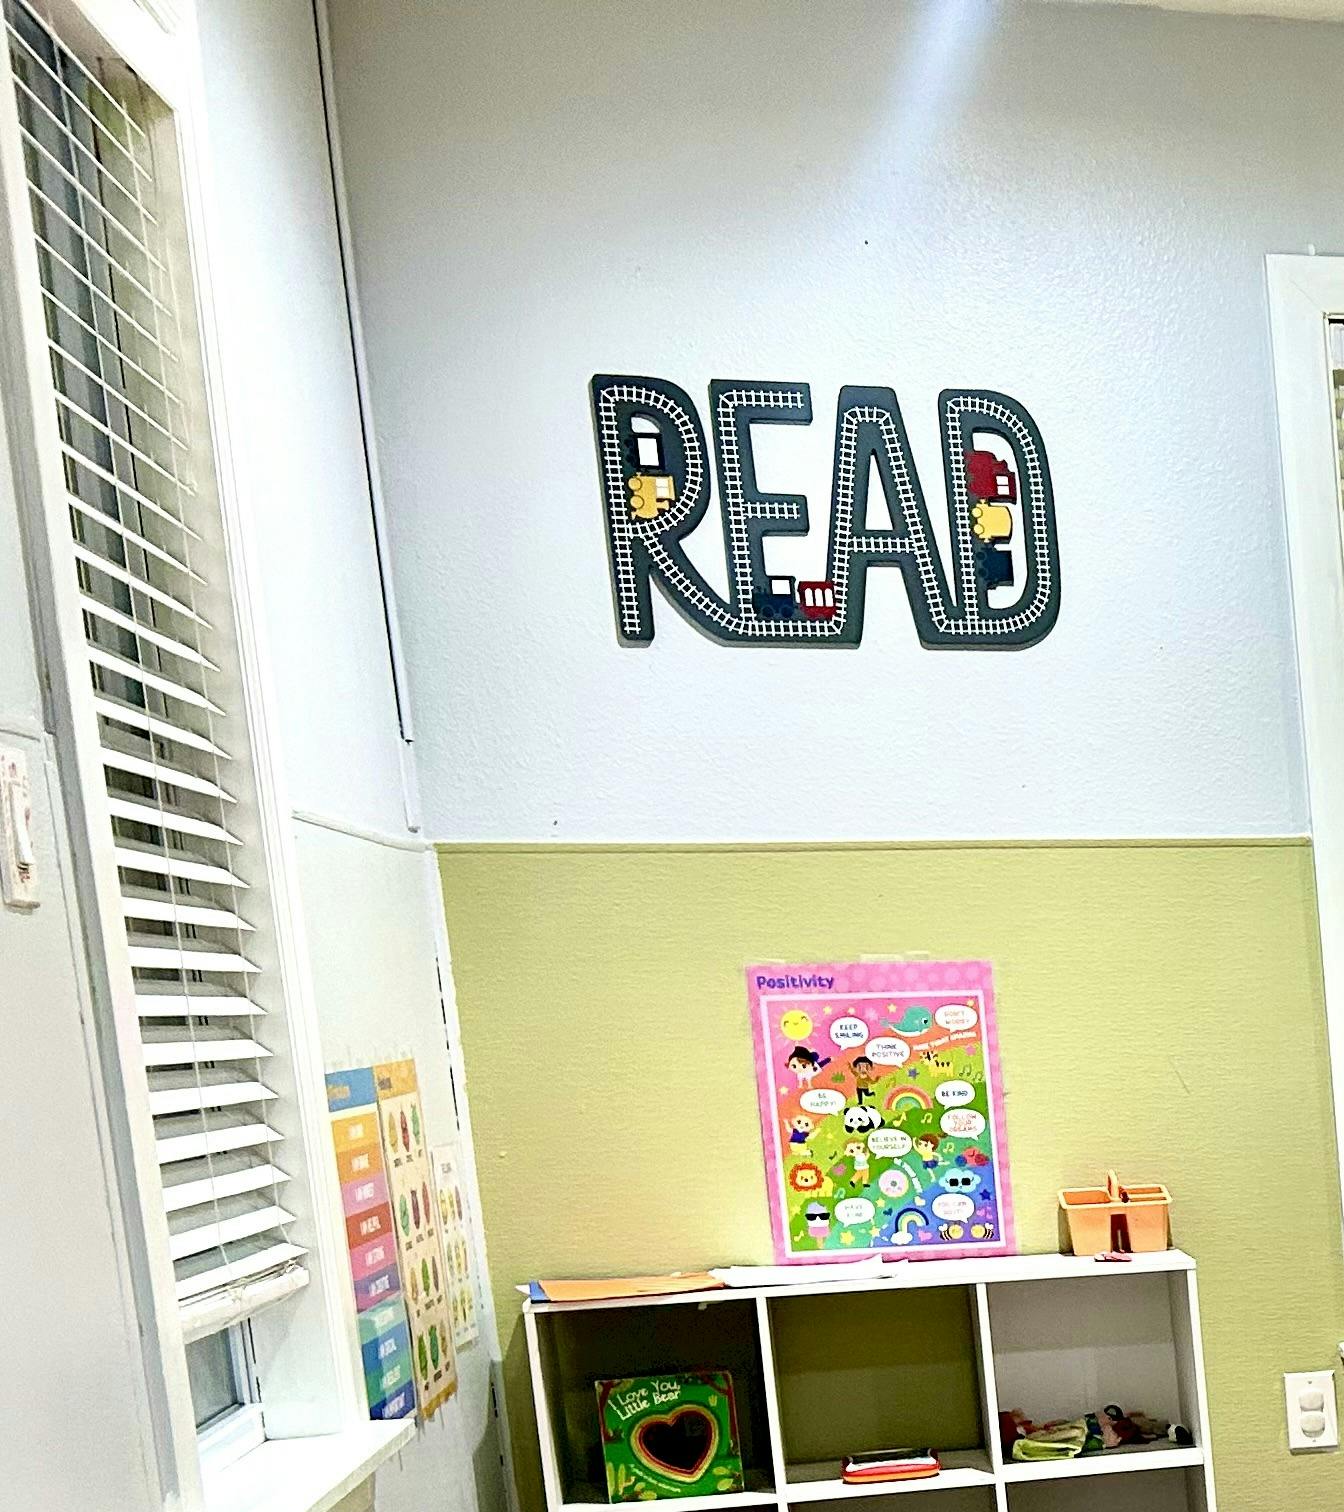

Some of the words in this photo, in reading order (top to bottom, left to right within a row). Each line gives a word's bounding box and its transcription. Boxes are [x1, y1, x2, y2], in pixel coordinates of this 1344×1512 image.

[588, 373, 1061, 651] READ
[756, 974, 834, 990] Positivity
[616, 1387, 649, 1406] Love
[652, 1390, 681, 1405] Bear
